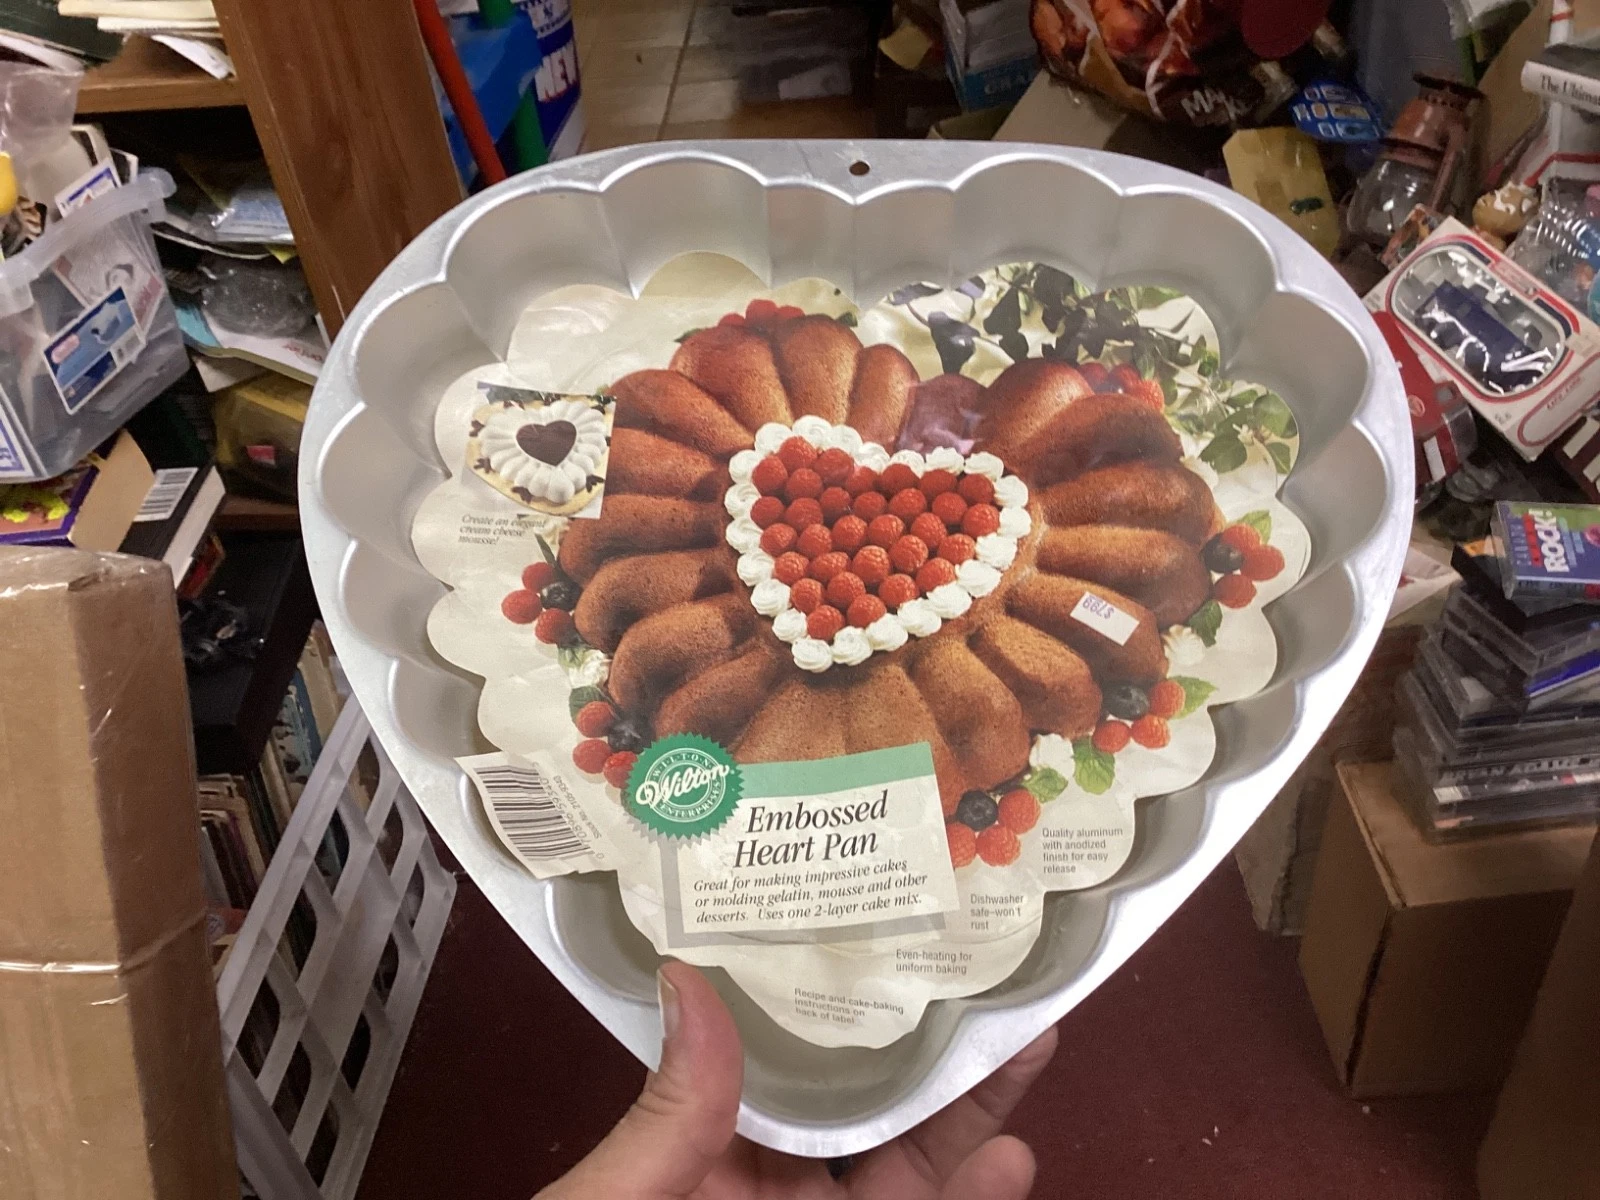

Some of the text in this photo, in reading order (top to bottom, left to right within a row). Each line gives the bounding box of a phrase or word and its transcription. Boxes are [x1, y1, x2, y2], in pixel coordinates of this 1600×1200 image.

[462, 513, 493, 525] Create
[495, 518, 508, 526] an
[460, 526, 524, 537] cream cheese
[1528, 508, 1570, 573] ROCK!
[636, 764, 730, 809] Wilton
[745, 788, 889, 834] Embossed
[1042, 827, 1123, 839] Quality aluminum
[732, 831, 878, 868] Heart Pan
[1042, 839, 1106, 850] with anodized
[1043, 851, 1109, 863] finish for easy
[693, 858, 908, 893] Great for making impressive cakes
[1043, 864, 1076, 874] release
[694, 873, 928, 907] or molding gelatin, mousse and other
[696, 891, 922, 924] desserts. Uses one 2-layer cake mix.
[970, 894, 1024, 905] Dishwasher
[971, 920, 989, 930] rust
[896, 949, 972, 963] Even-heating for
[896, 963, 967, 976] uniform baking
[794, 988, 904, 1015] Recipe and cake-baking
[794, 998, 865, 1017] instructions on
[795, 1006, 855, 1024] back of label
